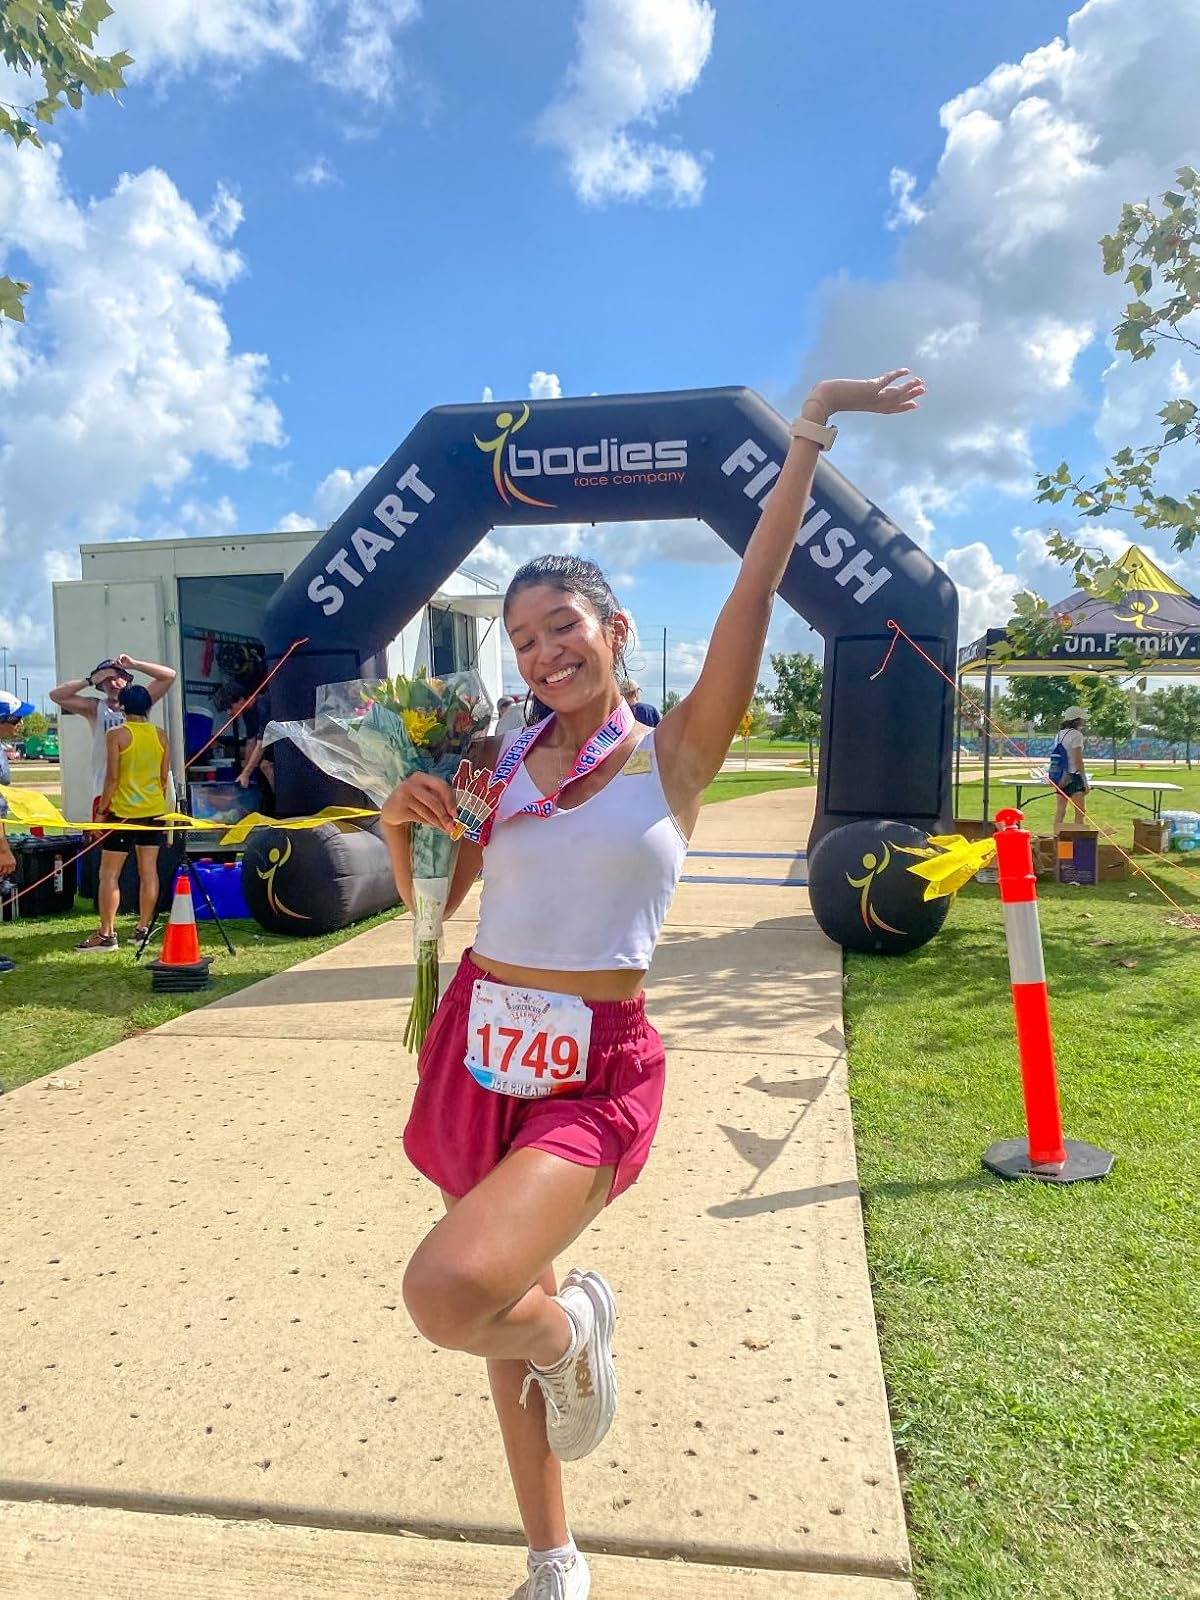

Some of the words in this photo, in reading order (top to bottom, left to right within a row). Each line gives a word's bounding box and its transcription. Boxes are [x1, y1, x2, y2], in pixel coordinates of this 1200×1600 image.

[508, 438, 688, 477] bodies
[574, 476, 609, 487] race
[612, 471, 685, 485] company
[307, 463, 436, 616] START
[720, 438, 893, 605] FIISH
[490, 727, 539, 786] FIRECRACK
[587, 745, 602, 756] 8
[593, 721, 623, 750] MILE
[476, 1023, 579, 1080] 1749
